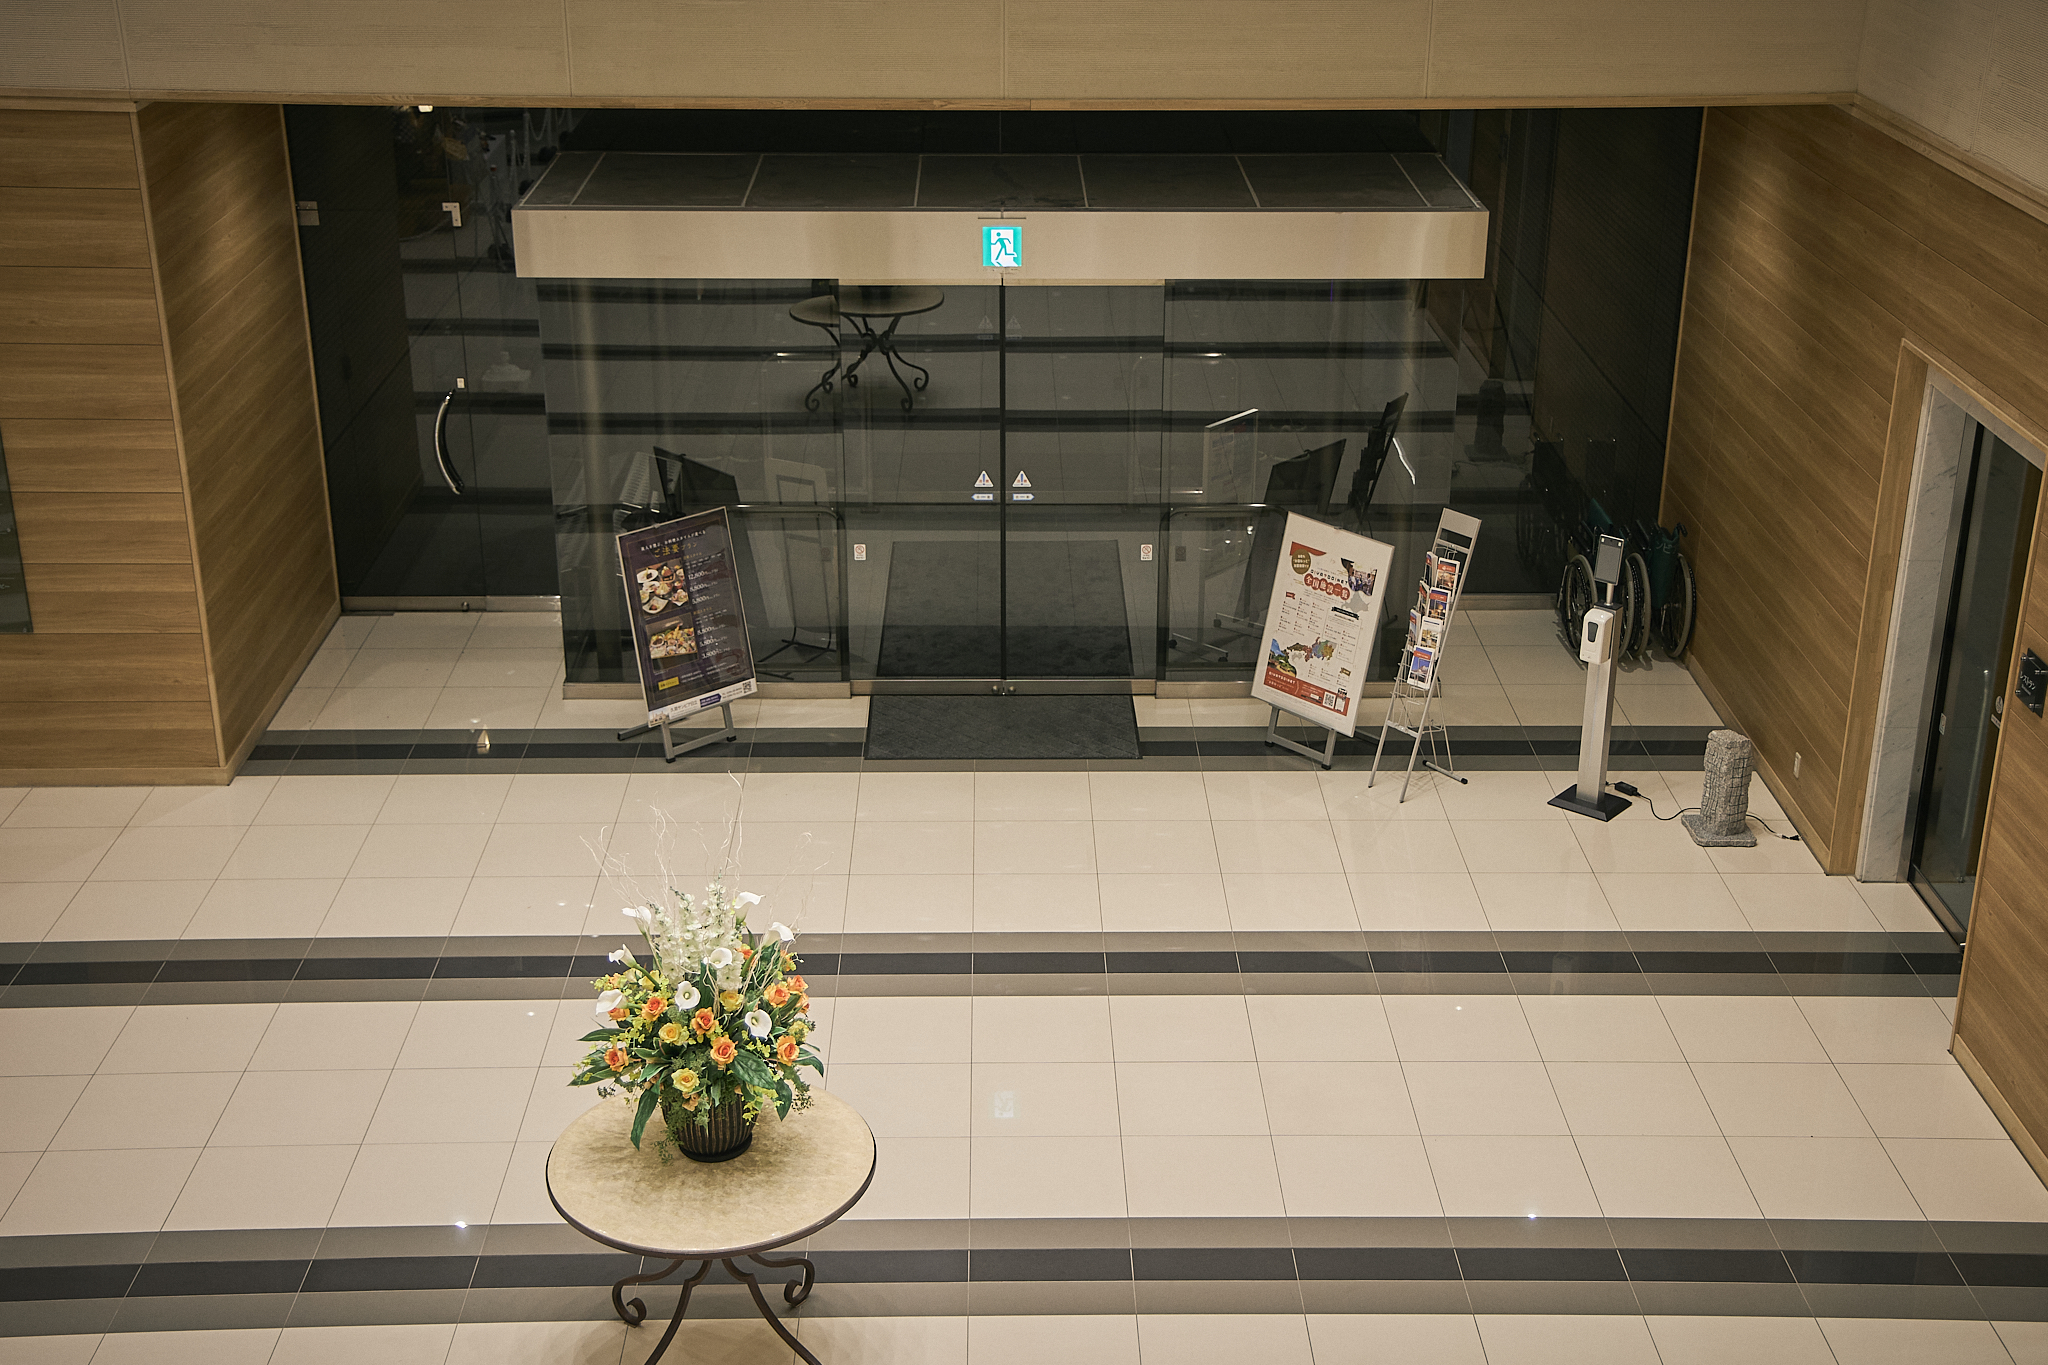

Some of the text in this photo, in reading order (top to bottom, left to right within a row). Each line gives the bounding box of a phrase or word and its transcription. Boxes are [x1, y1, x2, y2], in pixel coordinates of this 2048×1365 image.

[2019, 670, 2036, 690] レストラン
